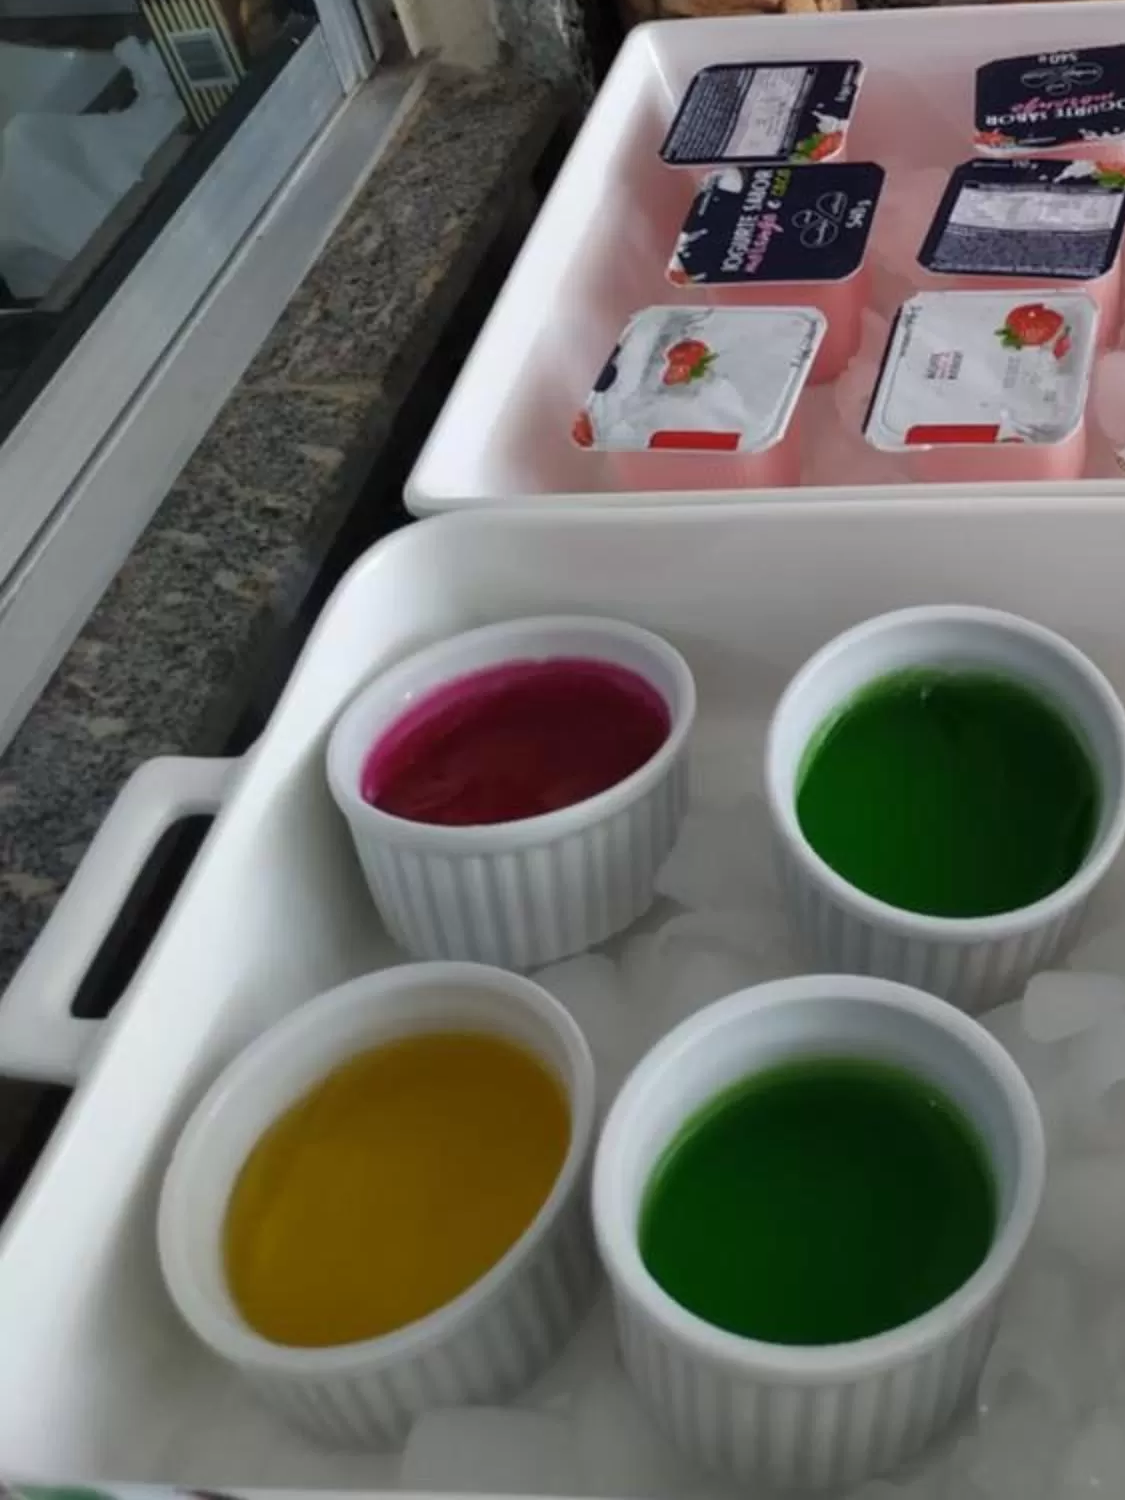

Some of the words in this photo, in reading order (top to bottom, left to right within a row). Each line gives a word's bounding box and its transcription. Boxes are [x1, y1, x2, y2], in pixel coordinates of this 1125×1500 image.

[985, 111, 1048, 126] SABOR
[720, 214, 759, 272] IOGURTE
[742, 169, 774, 212] SABOR
